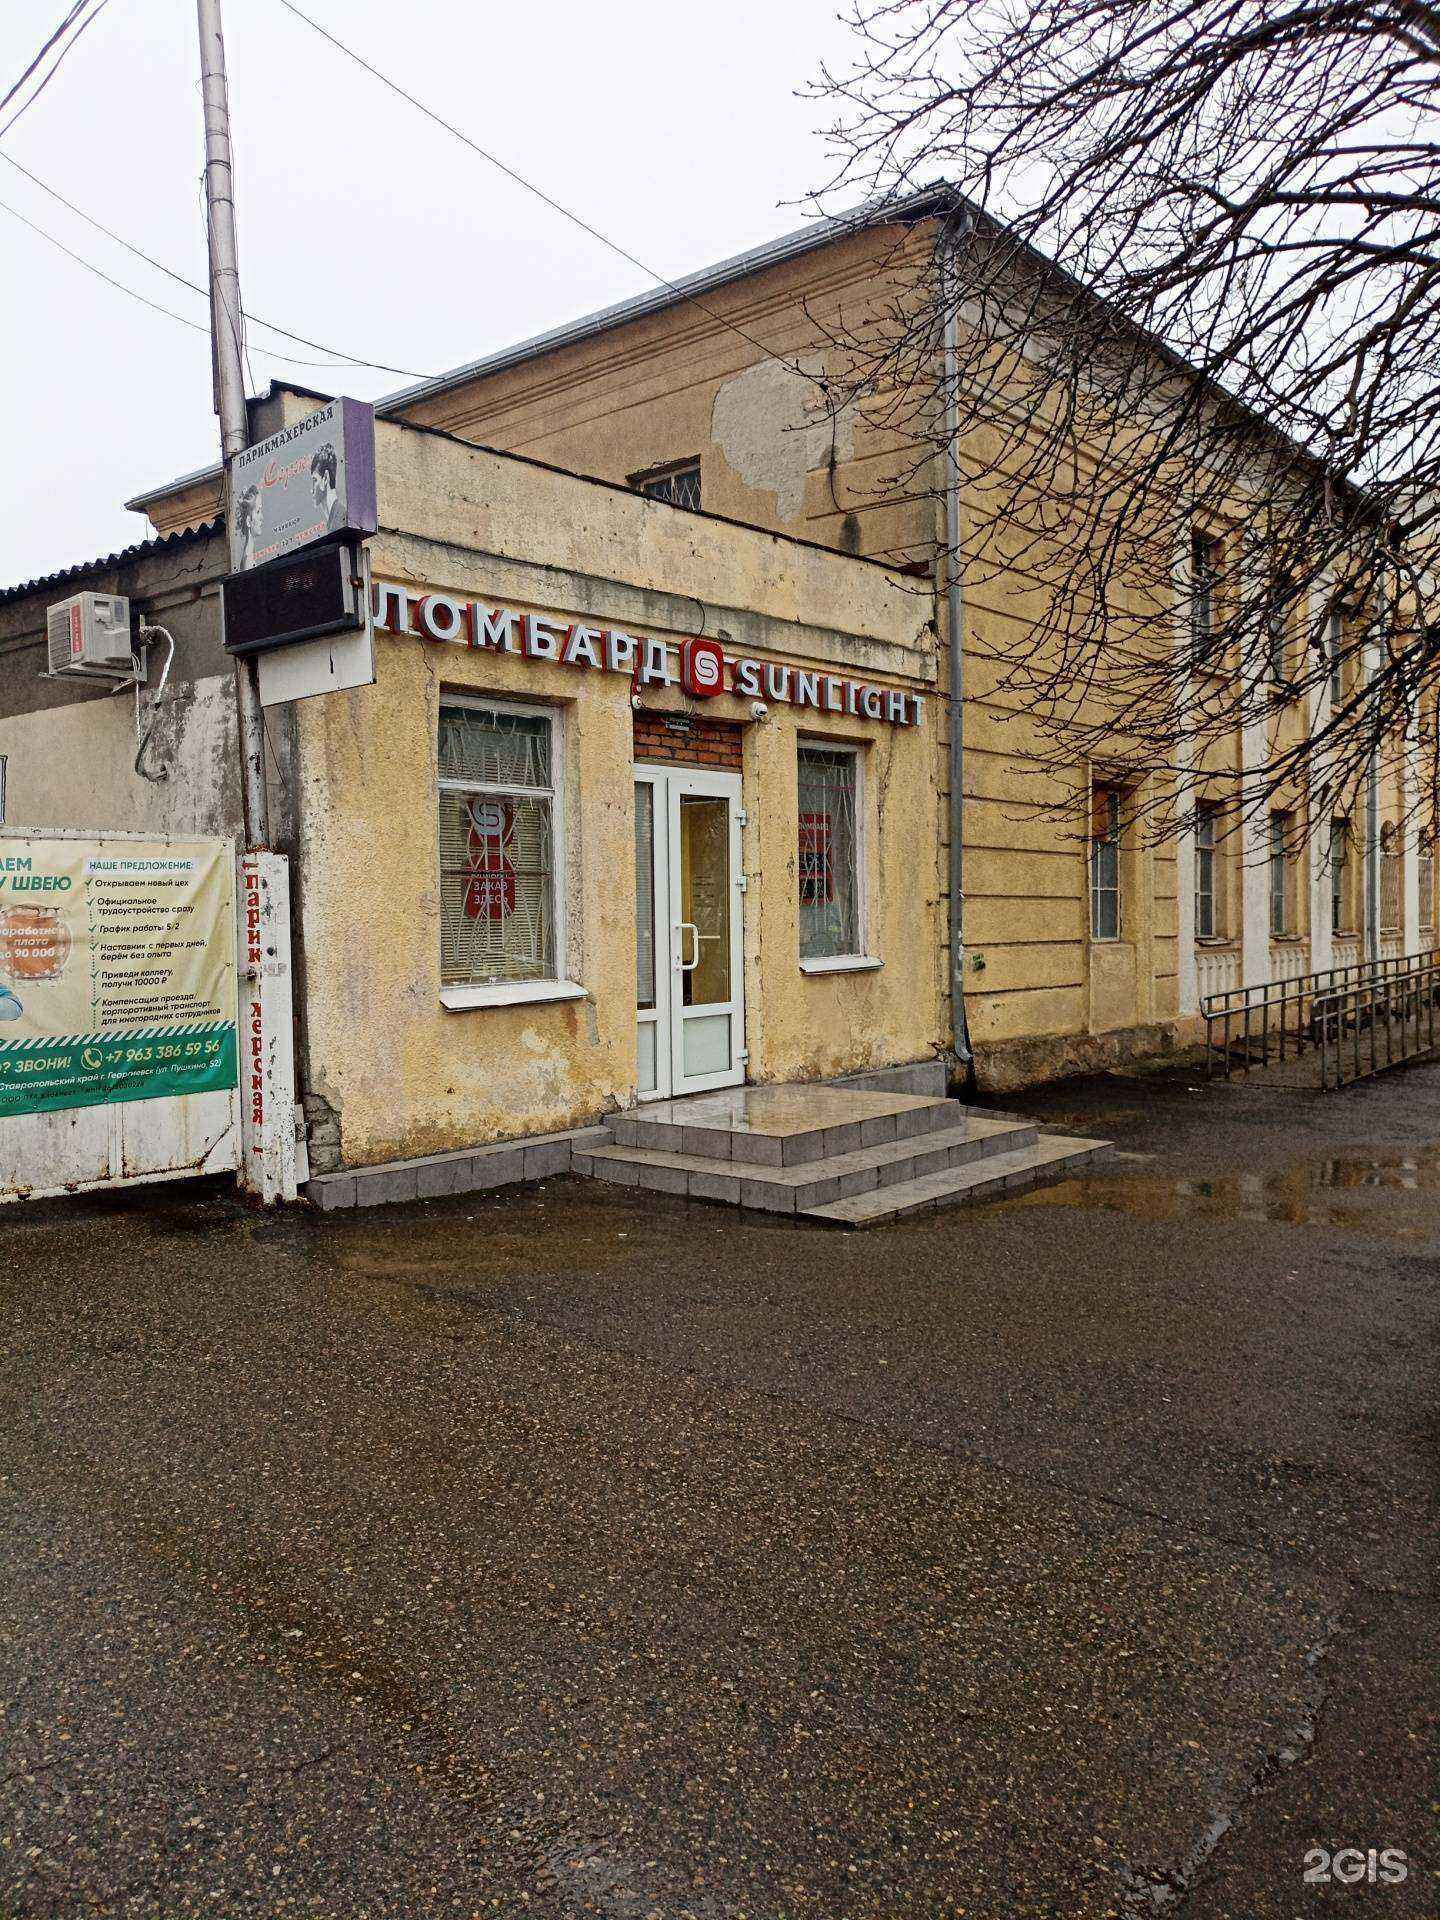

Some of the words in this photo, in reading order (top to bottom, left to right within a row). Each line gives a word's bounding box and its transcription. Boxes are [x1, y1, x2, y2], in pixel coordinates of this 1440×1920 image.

[239, 406, 334, 468] ПАРИКМАХЕРСКАЯ
[373, 582, 671, 687] ЛОМБАРД
[738, 659, 926, 726] SUNLIGHT
[90, 862, 118, 871] НАШЕ
[121, 861, 194, 871] ПРЕДЛОЖЕНИЕ:
[11, 876, 72, 891] ШВЕЮ
[95, 879, 146, 888] Открываем
[147, 878, 173, 887] новый
[174, 879, 190, 887] цех
[97, 897, 158, 906] Официальное
[98, 907, 170, 916] трудоустройство
[171, 905, 195, 914] сразу
[100, 925, 131, 935] График
[132, 924, 164, 933] работы
[166, 922, 180, 931] 5/2
[101, 943, 146, 952] Наставник
[155, 941, 185, 950] первых
[185, 939, 208, 948] дней,
[101, 953, 128, 961] берём
[146, 951, 172, 959] опыта
[102, 970, 140, 980] Приведи
[101, 980, 133, 989] получи
[135, 978, 160, 987] 10000
[101, 1005, 169, 1016] корпоративный
[170, 1000, 211, 1010] транспорт
[102, 996, 159, 1007] Компенсация
[101, 1017, 117, 1026] для
[118, 1011, 173, 1023] иногородних
[105, 1050, 123, 1063] +7
[126, 1046, 153, 1062] 963
[156, 1044, 181, 1059] 386
[184, 1042, 202, 1056] 59
[204, 1039, 220, 1054] 56
[14, 1056, 72, 1073] ЗВОНИ!
[0, 1077, 75, 1091] Ставропольский
